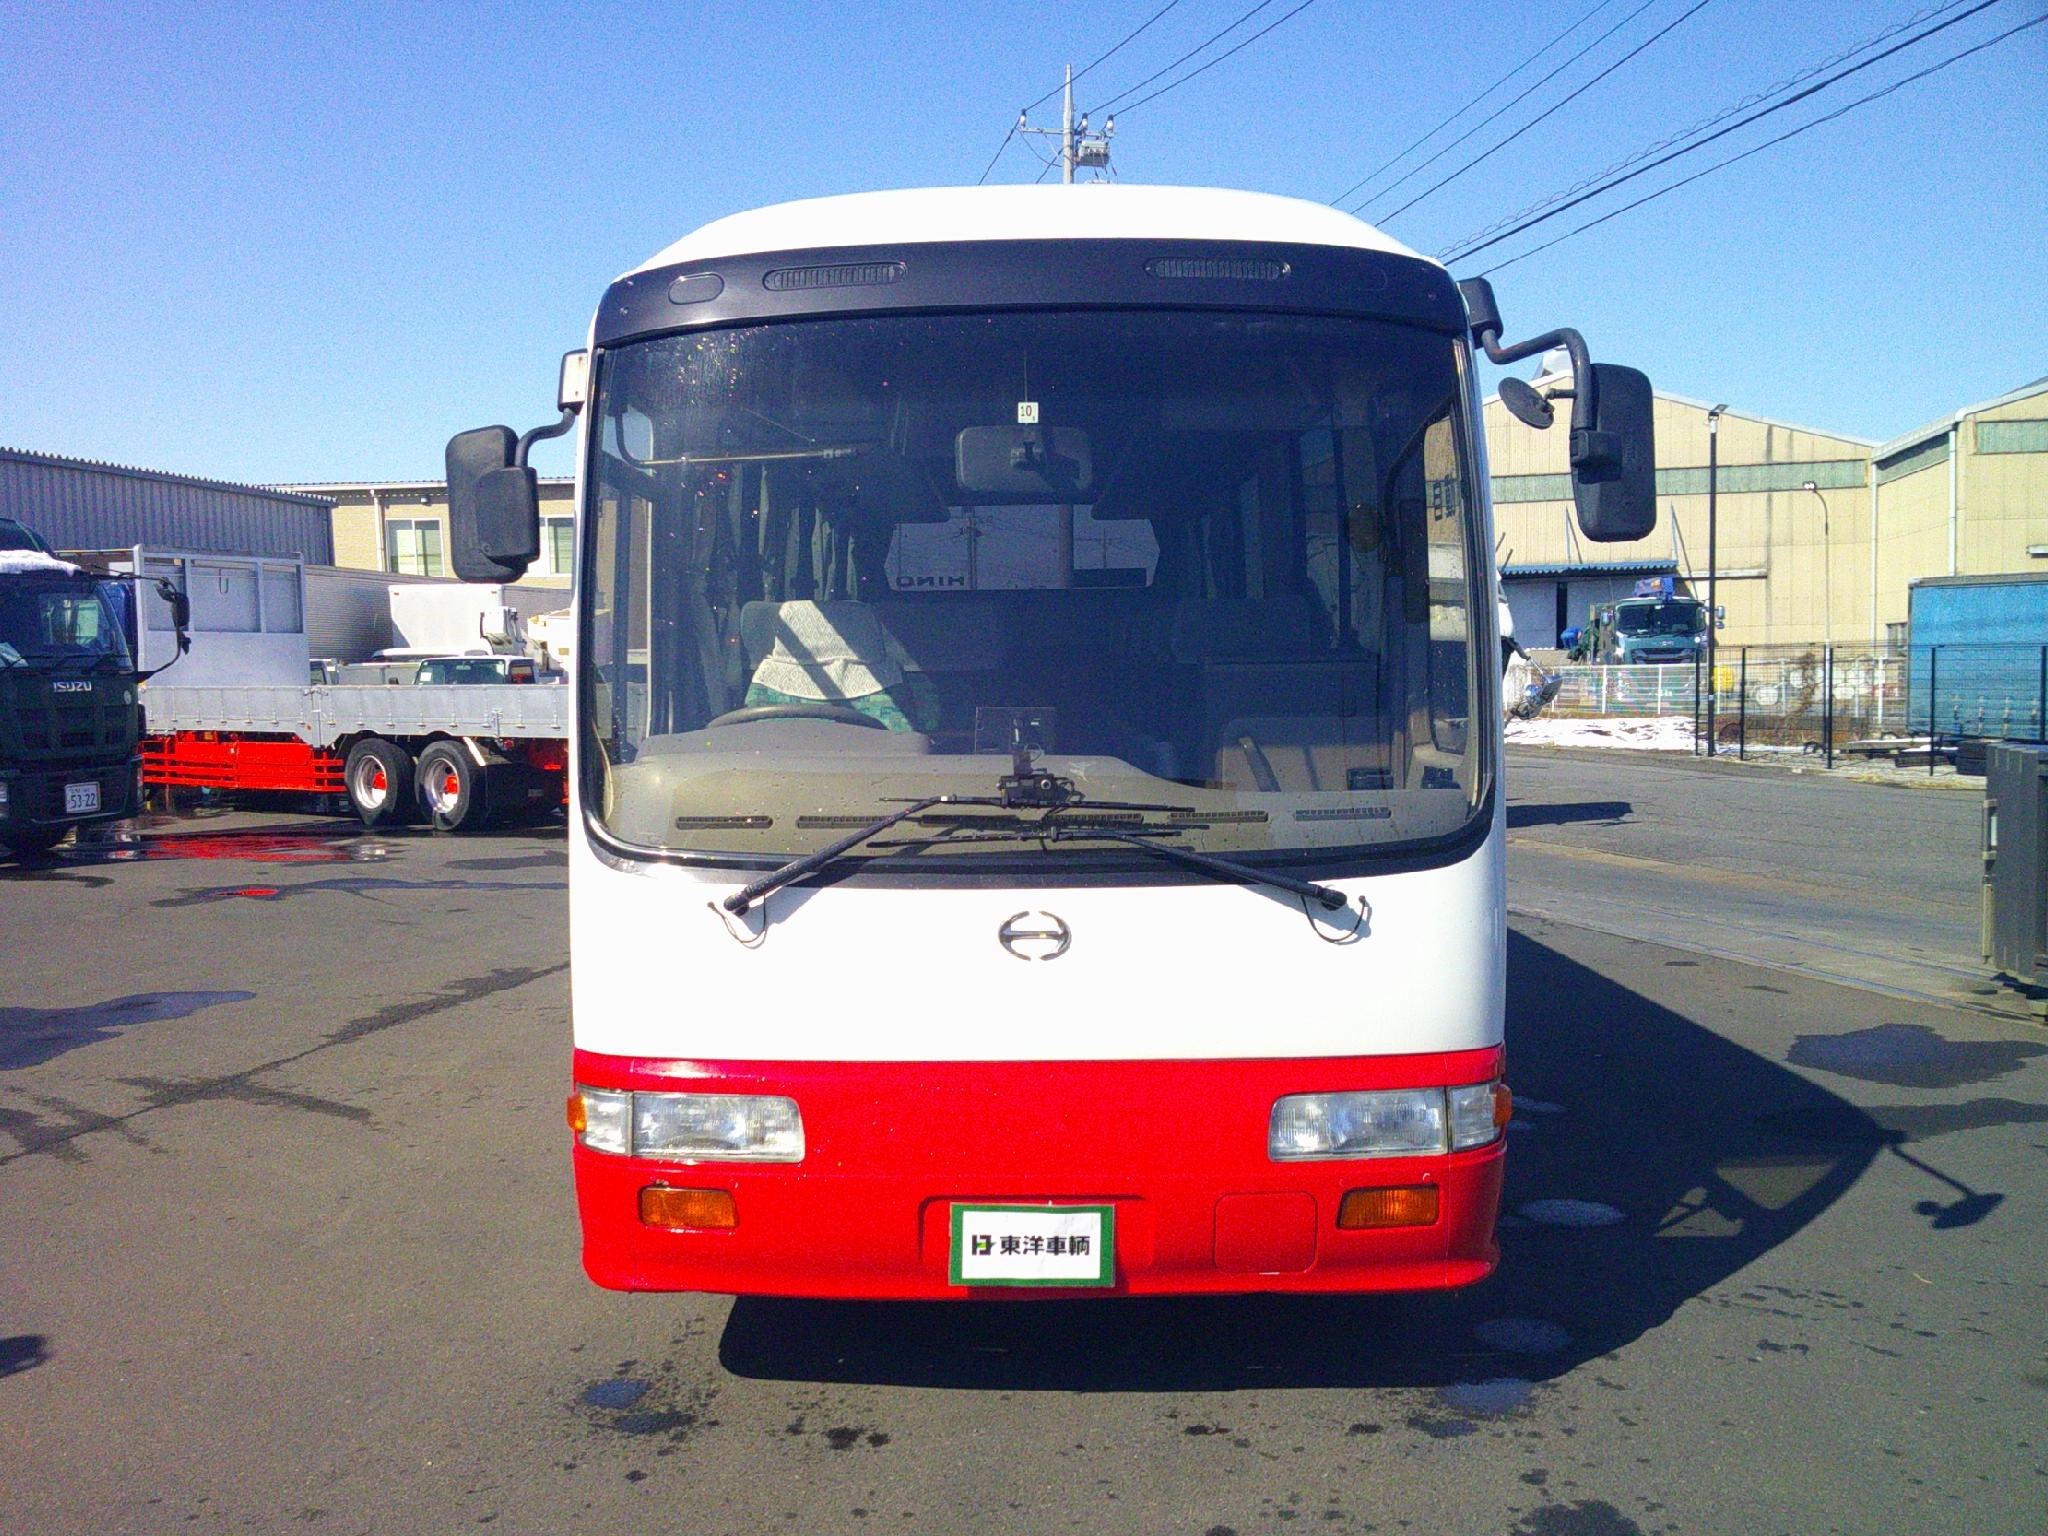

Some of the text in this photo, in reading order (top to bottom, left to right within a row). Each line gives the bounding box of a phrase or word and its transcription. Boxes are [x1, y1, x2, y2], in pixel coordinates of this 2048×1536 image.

[53, 681, 92, 692] ISUZU
[1000, 1235, 1090, 1256] 東洋車輌
